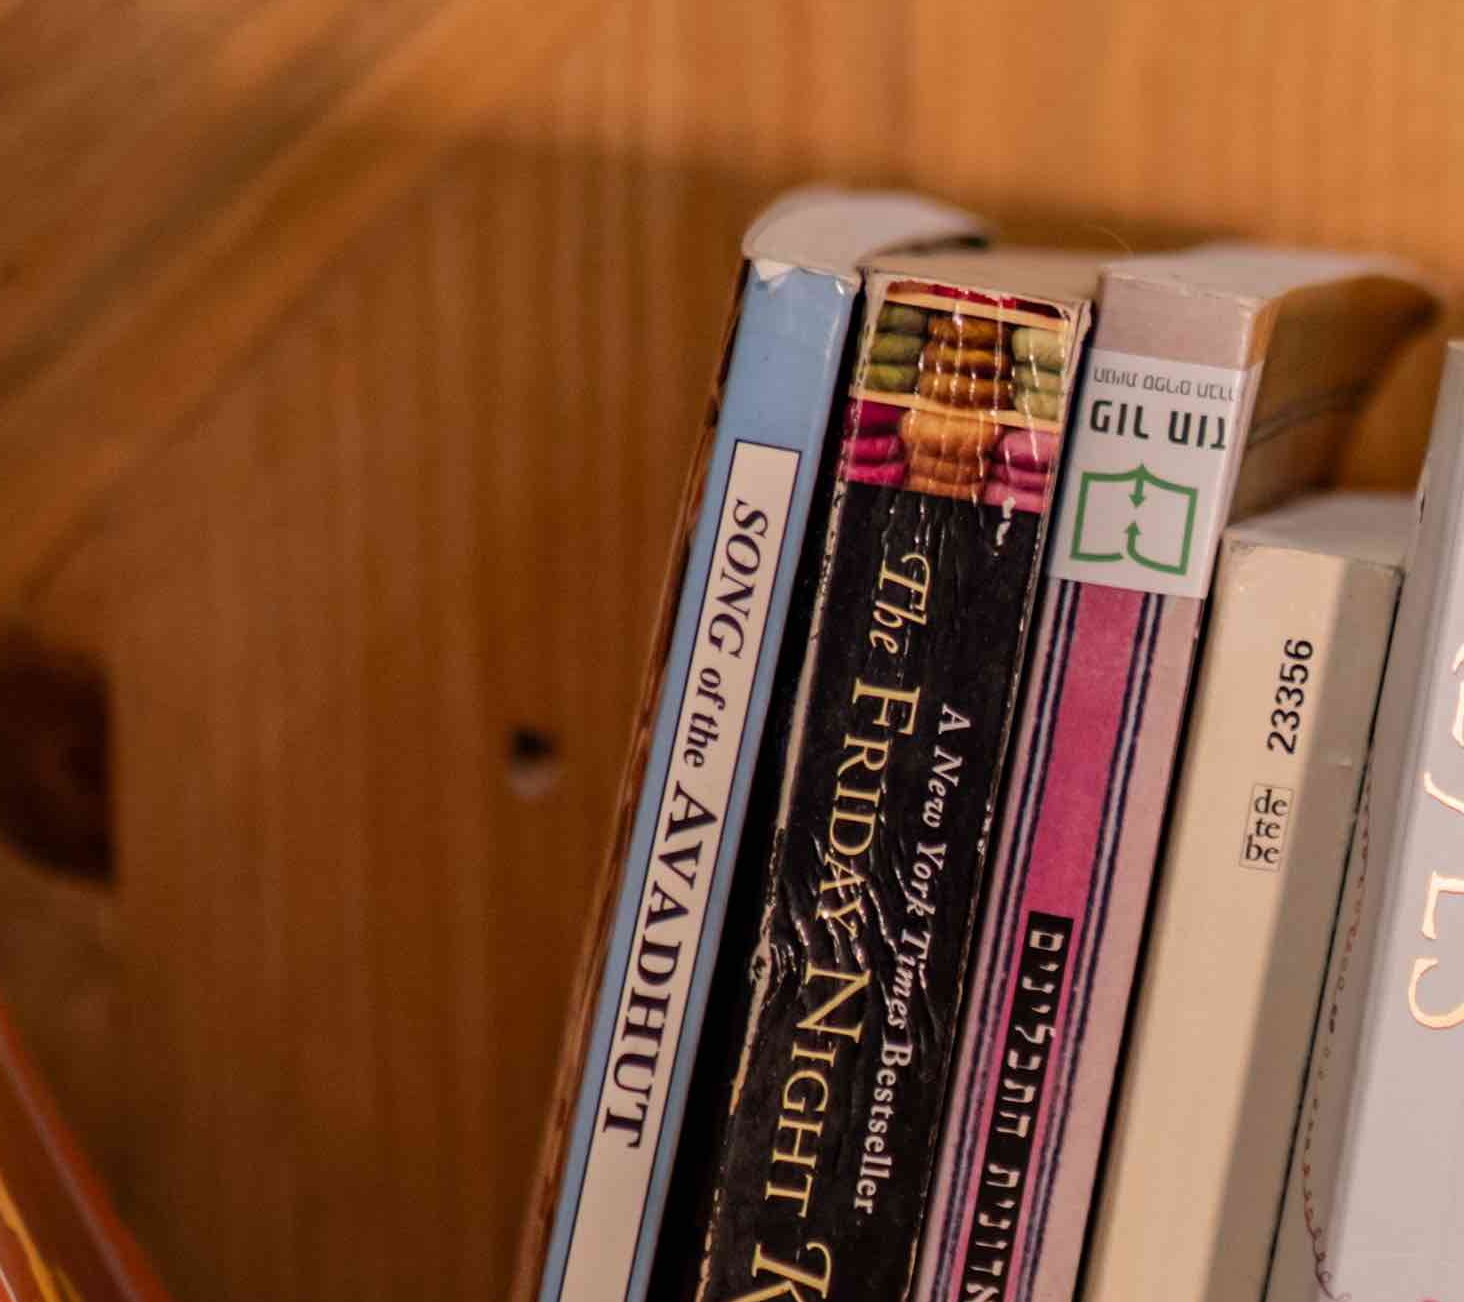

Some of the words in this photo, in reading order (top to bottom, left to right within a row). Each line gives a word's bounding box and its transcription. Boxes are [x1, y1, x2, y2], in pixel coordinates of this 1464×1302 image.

[1090, 400, 1149, 439] פור
[1169, 411, 1228, 451] חוז
[1143, 373, 1192, 396] ספרים
[707, 499, 769, 659] SONG
[868, 551, 931, 655] The
[696, 665, 726, 712] of
[940, 703, 971, 736] A
[1267, 639, 1314, 755] 23356
[683, 711, 721, 768] the
[819, 677, 923, 938] FRIDAY
[921, 743, 963, 828] New
[1254, 789, 1287, 816] de
[1245, 835, 1280, 864] be
[1255, 818, 1281, 840] te
[904, 840, 949, 922] York
[602, 781, 718, 1150] AVADHUT
[886, 921, 931, 1030] Times
[996, 930, 1064, 1139] התבלינים
[764, 961, 873, 1217] NIGHT
[853, 1043, 913, 1215] Bestseller
